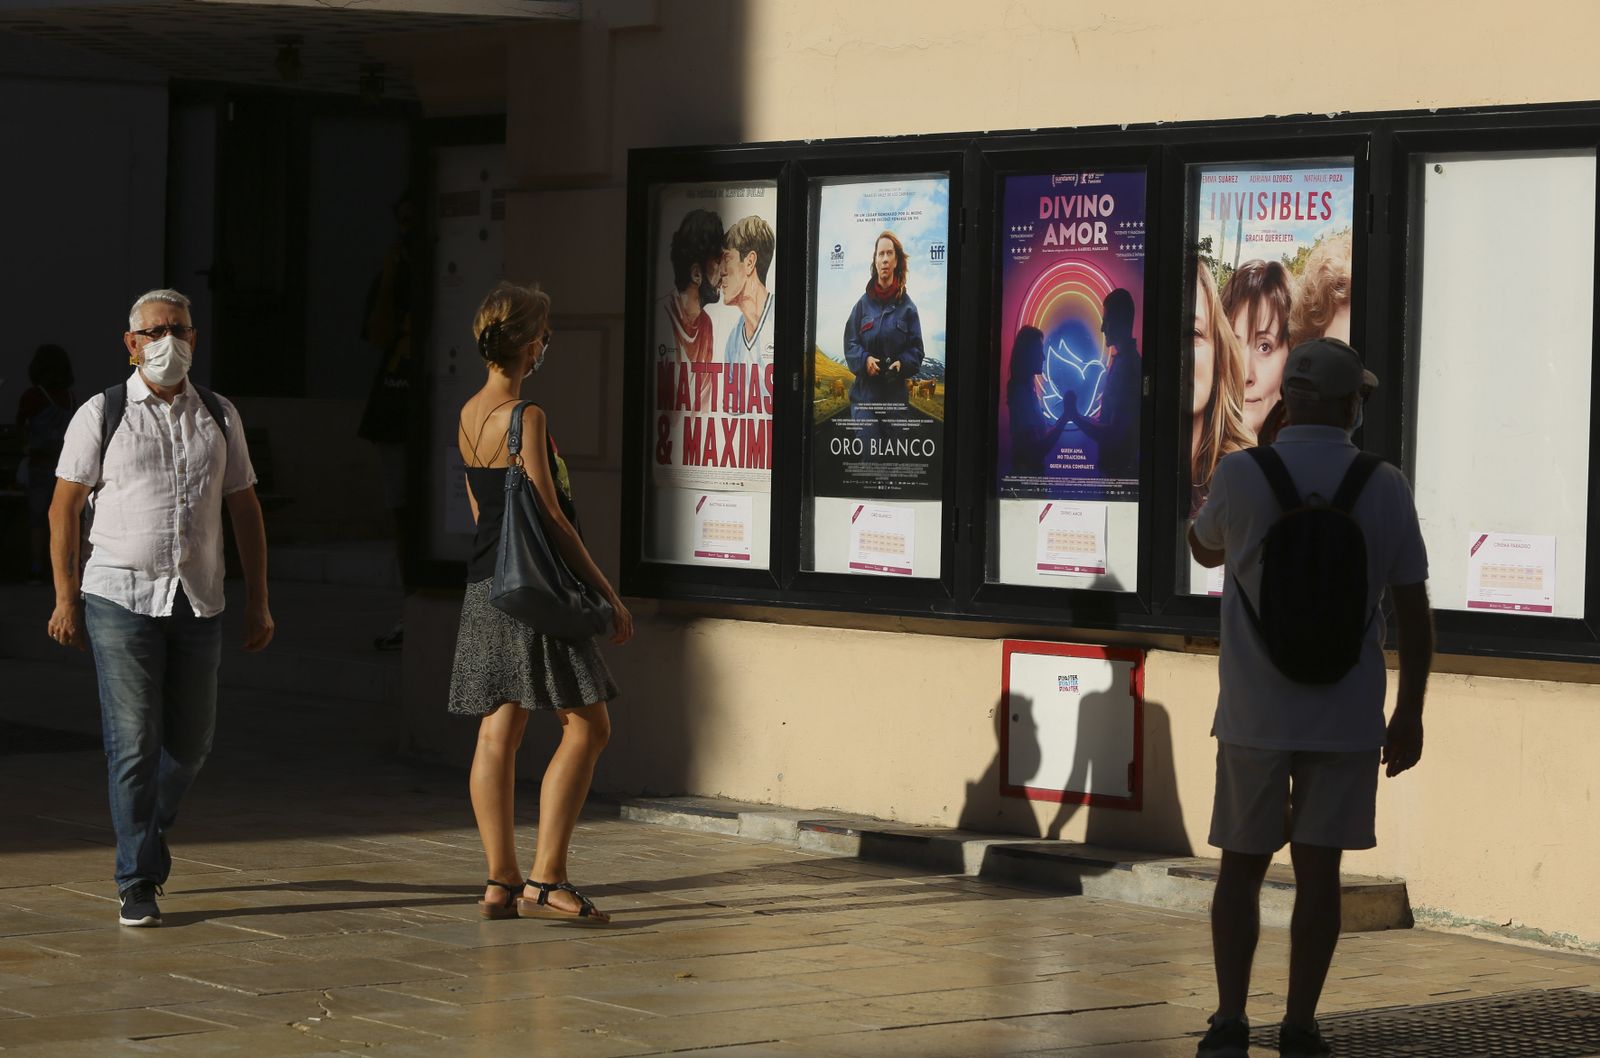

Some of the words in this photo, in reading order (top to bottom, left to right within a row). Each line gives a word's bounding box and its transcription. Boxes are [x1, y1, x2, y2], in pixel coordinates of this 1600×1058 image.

[1218, 174, 1238, 183] SUÁREZ
[1272, 174, 1292, 182] OZORES
[1329, 174, 1344, 182] POZA
[1040, 194, 1114, 219] DIVINO
[1211, 191, 1332, 220] INVISIBLES
[1043, 222, 1108, 246] AMOR
[1265, 234, 1293, 242] QUEREJETA
[930, 245, 945, 259] tiff
[656, 362, 774, 414] MATTHIAS
[656, 414, 672, 465] &
[831, 438, 863, 455] ORO
[870, 438, 935, 456] BLANCO
